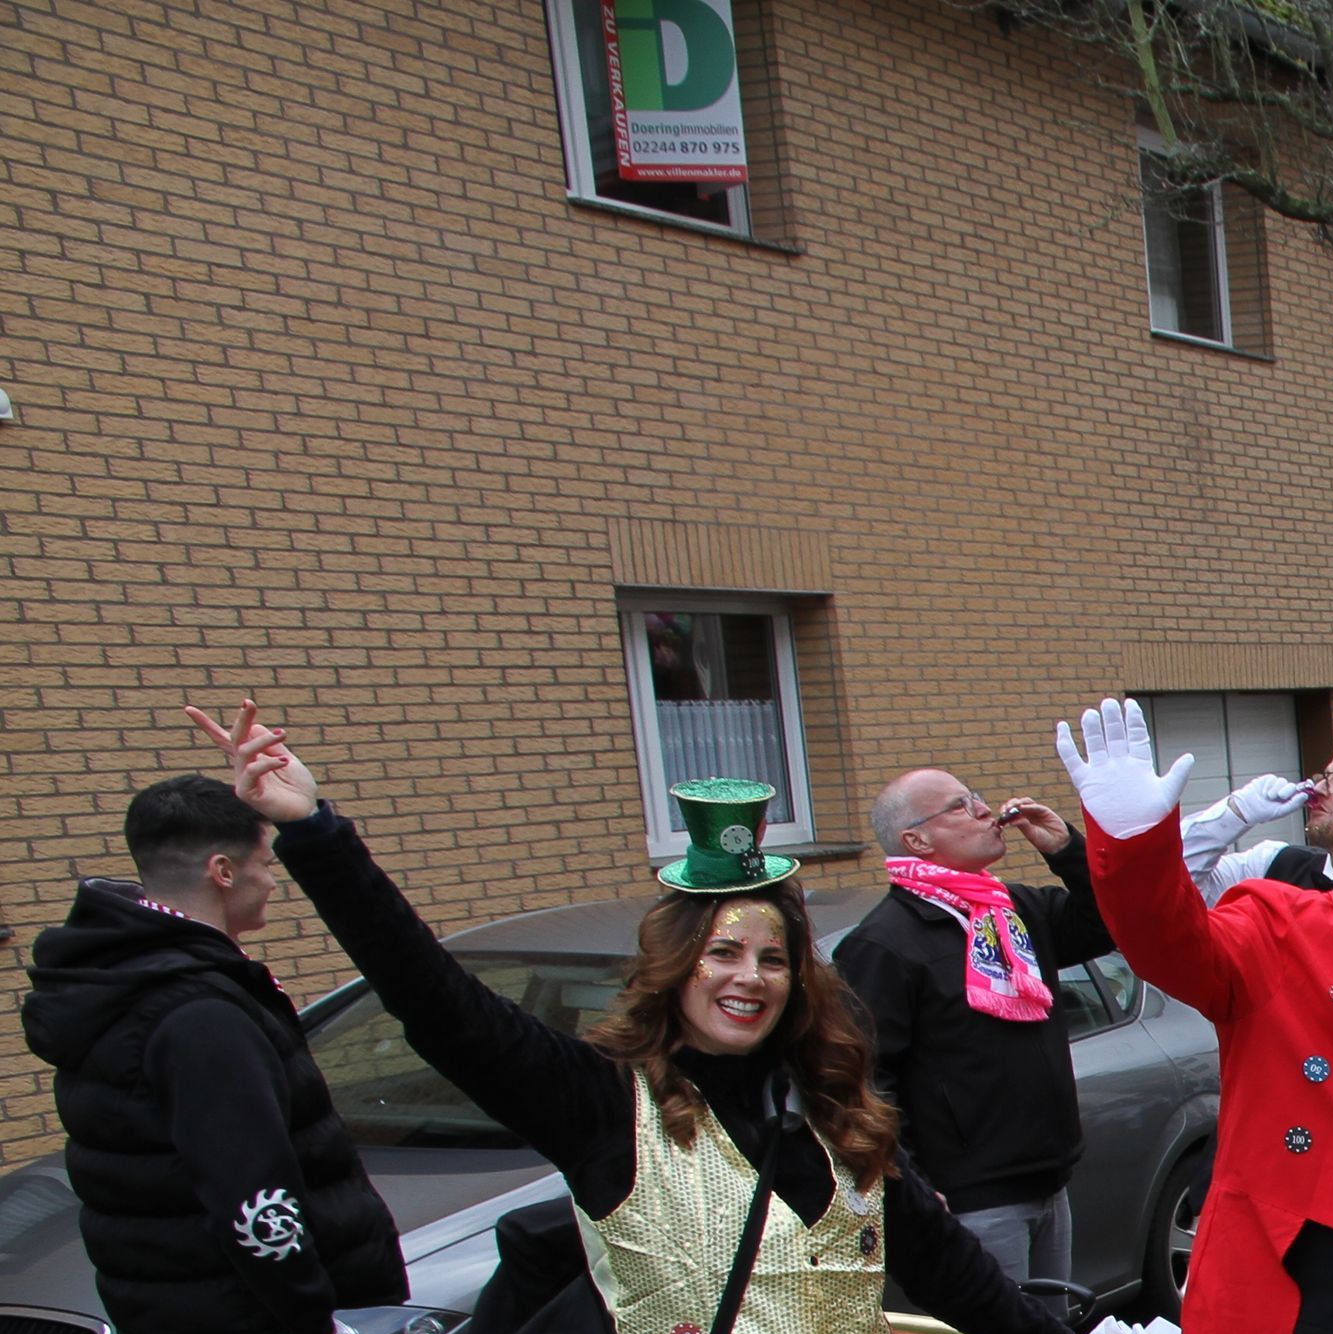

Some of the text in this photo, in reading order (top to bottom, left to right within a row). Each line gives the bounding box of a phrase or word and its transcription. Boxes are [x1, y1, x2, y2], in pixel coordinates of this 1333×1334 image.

[603, 5, 631, 168] ZU VERKAUFEN
[631, 122, 739, 137] DoeringImmobilien
[632, 140, 741, 154] 02244 870 975
[636, 167, 741, 177] www.villenmakler.de
[1309, 1063, 1323, 1075] 50
[1292, 1135, 1305, 1145] 100
